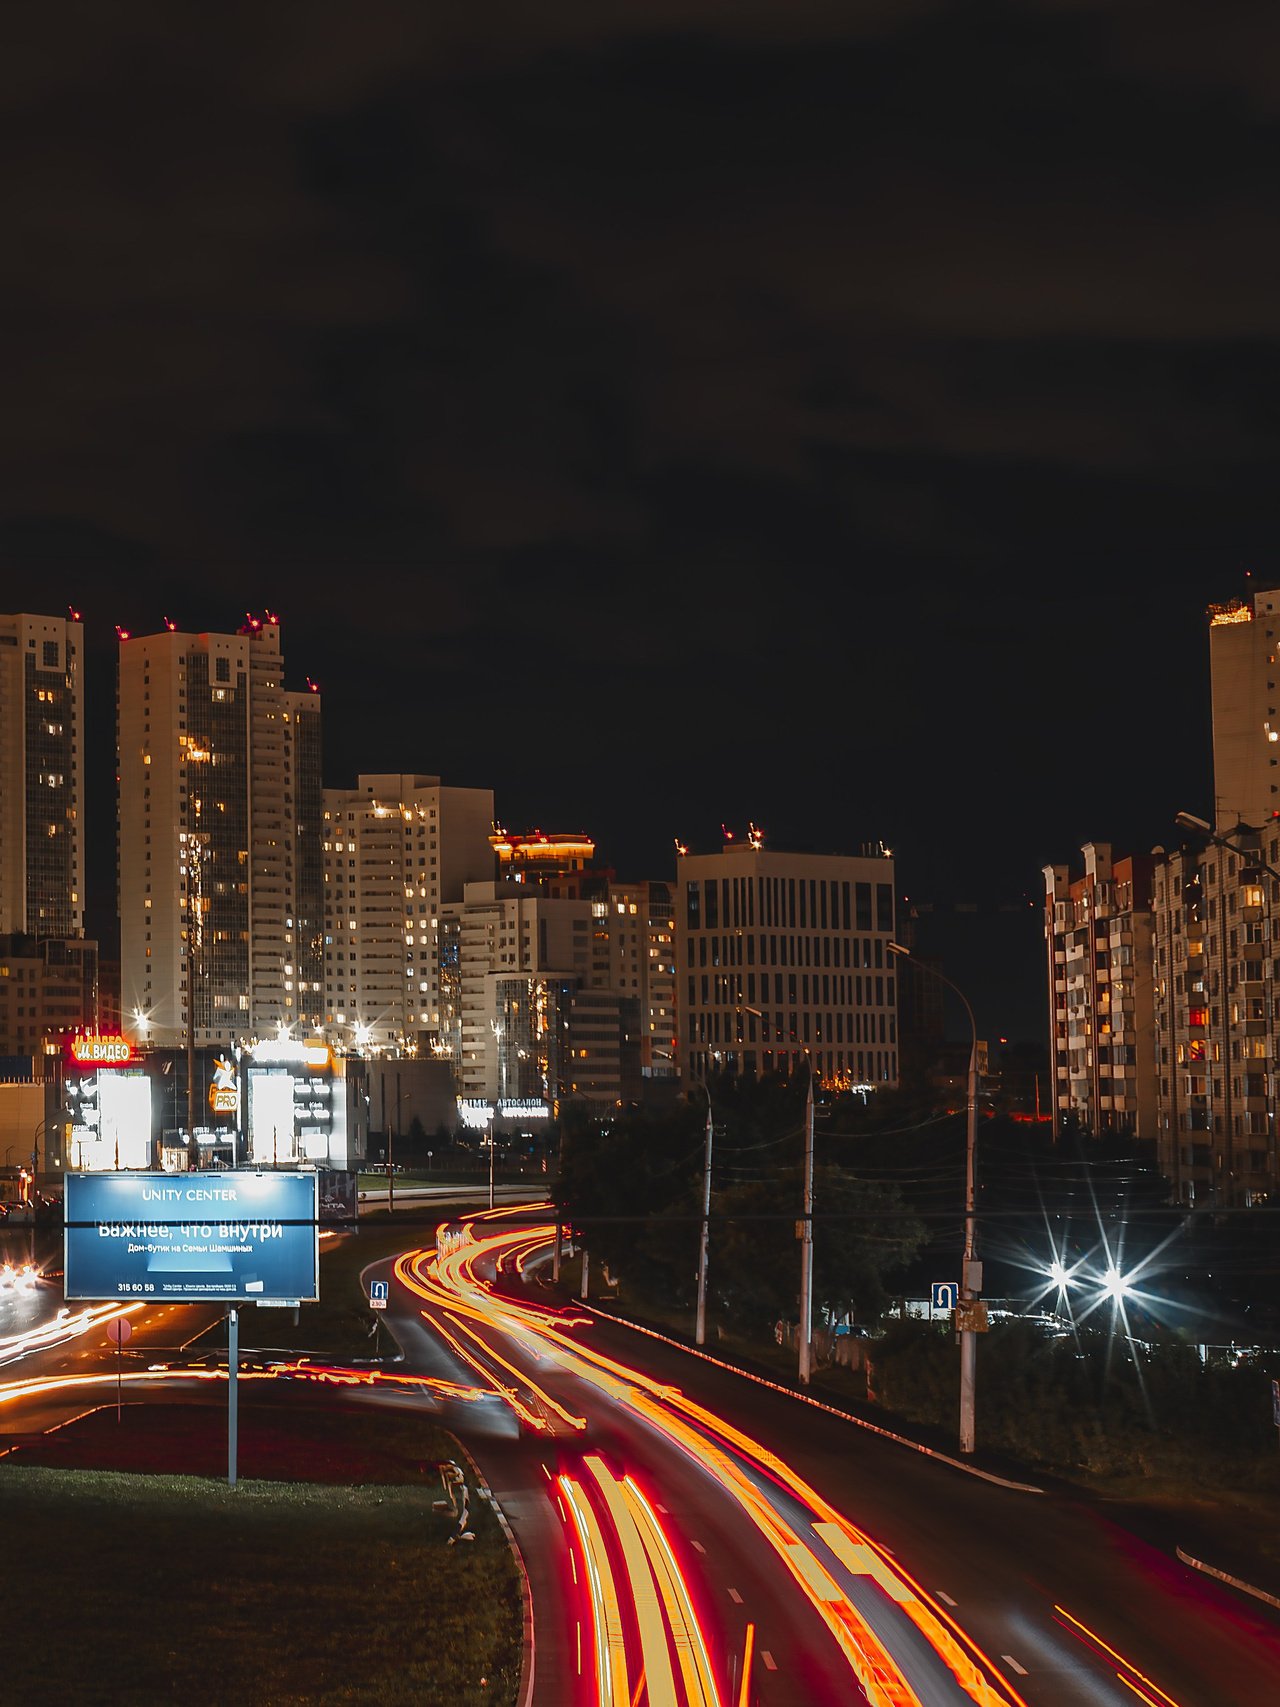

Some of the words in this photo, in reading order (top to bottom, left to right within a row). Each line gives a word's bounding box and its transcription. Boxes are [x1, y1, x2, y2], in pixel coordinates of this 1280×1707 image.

[216, 1095, 237, 1107] PRO
[142, 1189, 182, 1201] UNITY
[186, 1189, 237, 1201] CENTER
[180, 1225, 212, 1238] что
[219, 1224, 283, 1242] внутри
[128, 1243, 170, 1253] Дом-бутик
[182, 1244, 208, 1252] Семьи
[209, 1244, 253, 1253] Шамшиных
[118, 1283, 131, 1292] 315
[132, 1283, 143, 1292] 60
[144, 1283, 155, 1292] 58
